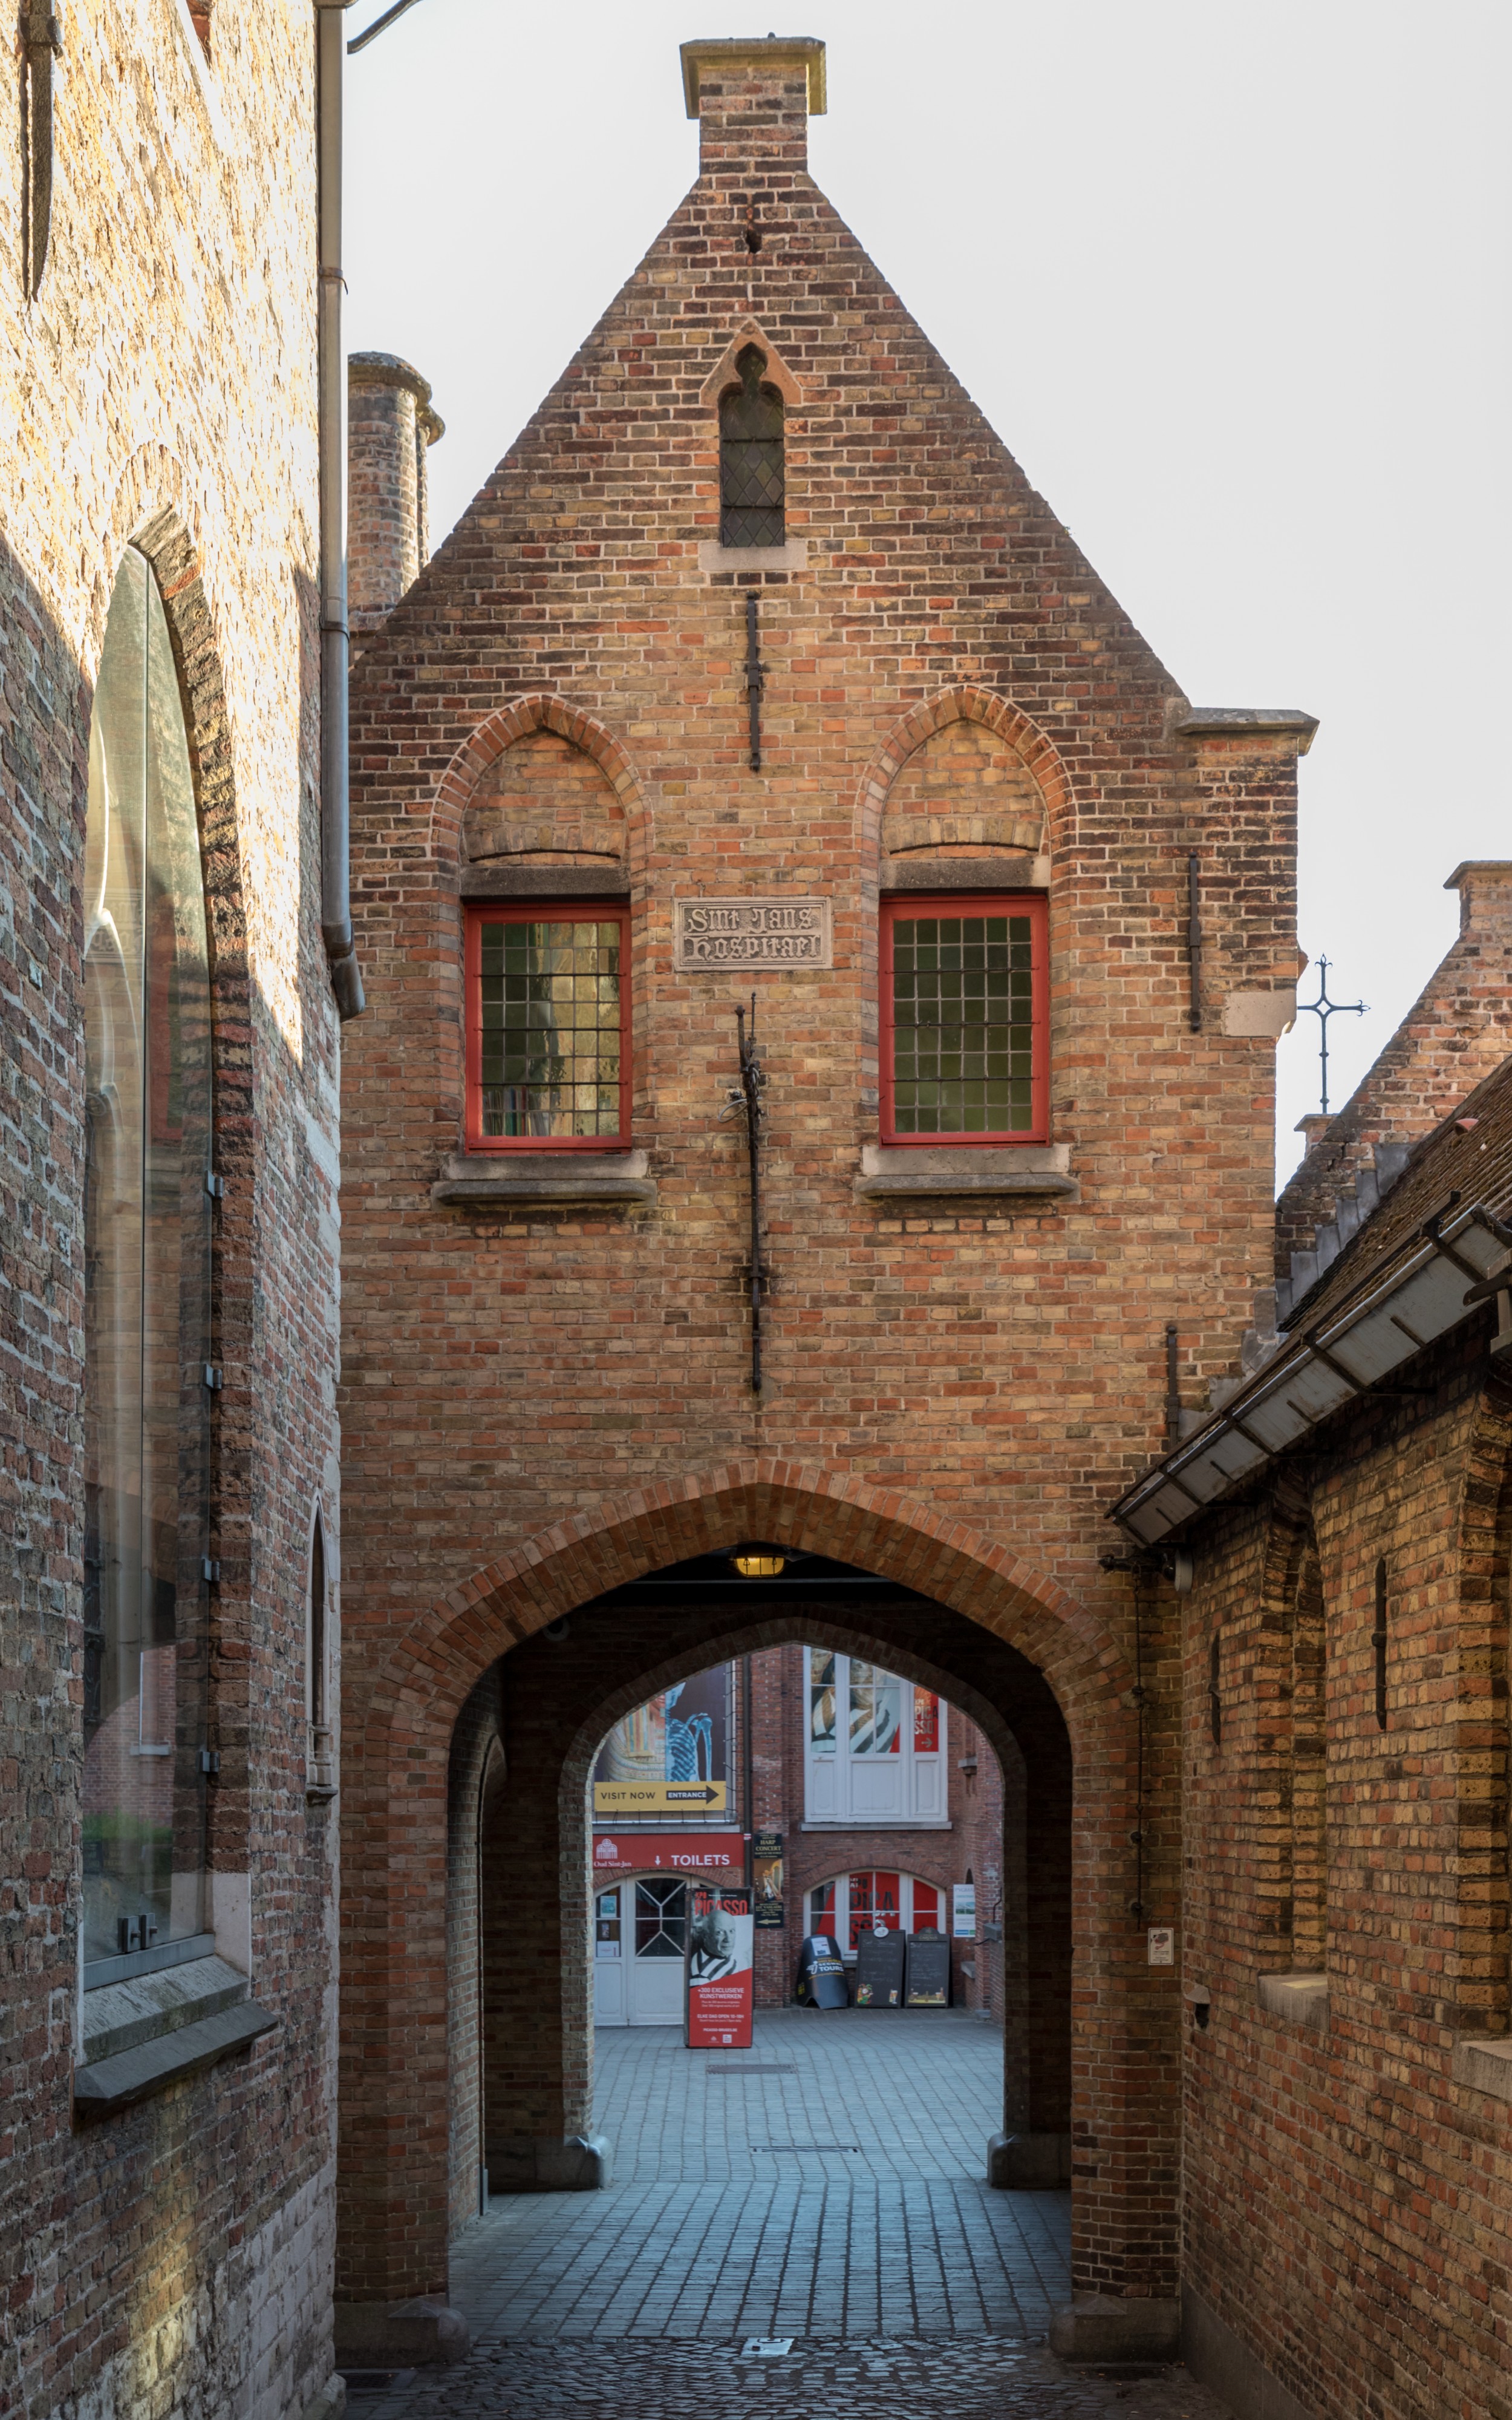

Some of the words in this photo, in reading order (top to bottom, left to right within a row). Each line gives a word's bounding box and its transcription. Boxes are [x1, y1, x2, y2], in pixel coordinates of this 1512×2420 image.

[687, 908, 740, 933] Sint
[747, 908, 812, 934] Jans
[914, 1705, 939, 1719] PICA
[914, 1720, 934, 1735] SSO
[600, 1791, 627, 1800] VISIT
[671, 1854, 730, 1866] TOILETS
[694, 1899, 748, 1917] PICASSO
[849, 1891, 896, 1917] PICA
